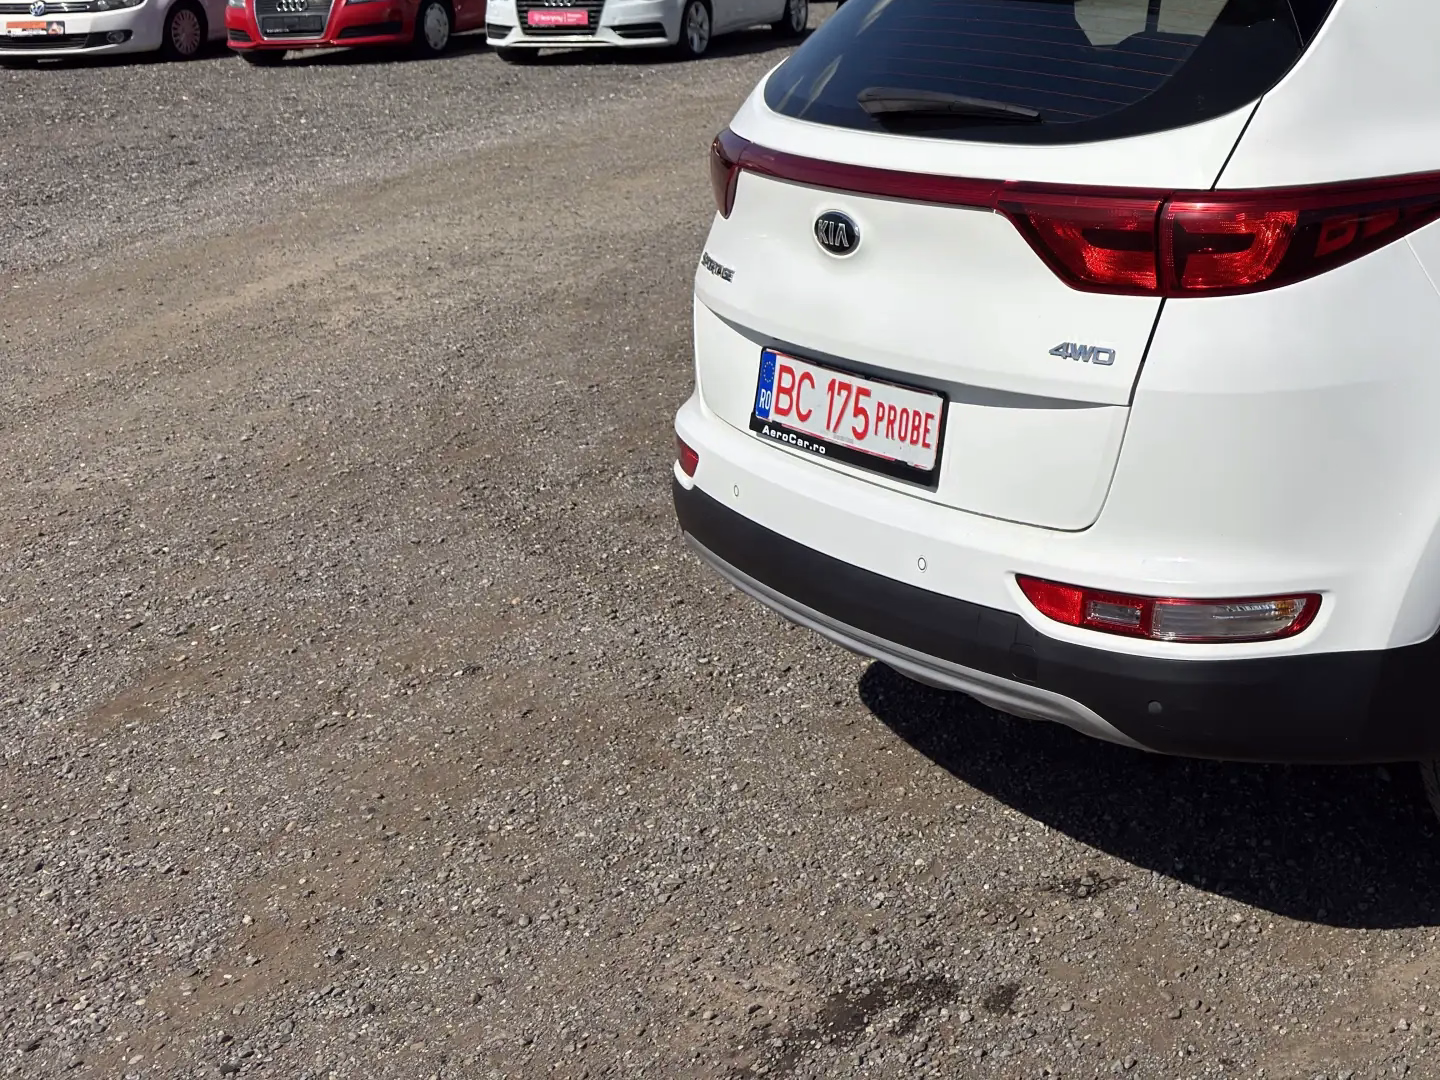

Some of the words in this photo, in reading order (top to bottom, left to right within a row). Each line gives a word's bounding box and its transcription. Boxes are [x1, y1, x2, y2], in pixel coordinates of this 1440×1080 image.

[817, 219, 850, 247] KIA
[1048, 341, 1116, 366] 4WD
[759, 388, 772, 410] RO
[773, 364, 816, 422] BC
[825, 378, 872, 441] 175
[874, 400, 936, 449] PROBE
[761, 424, 827, 455] AeroCar.ro
